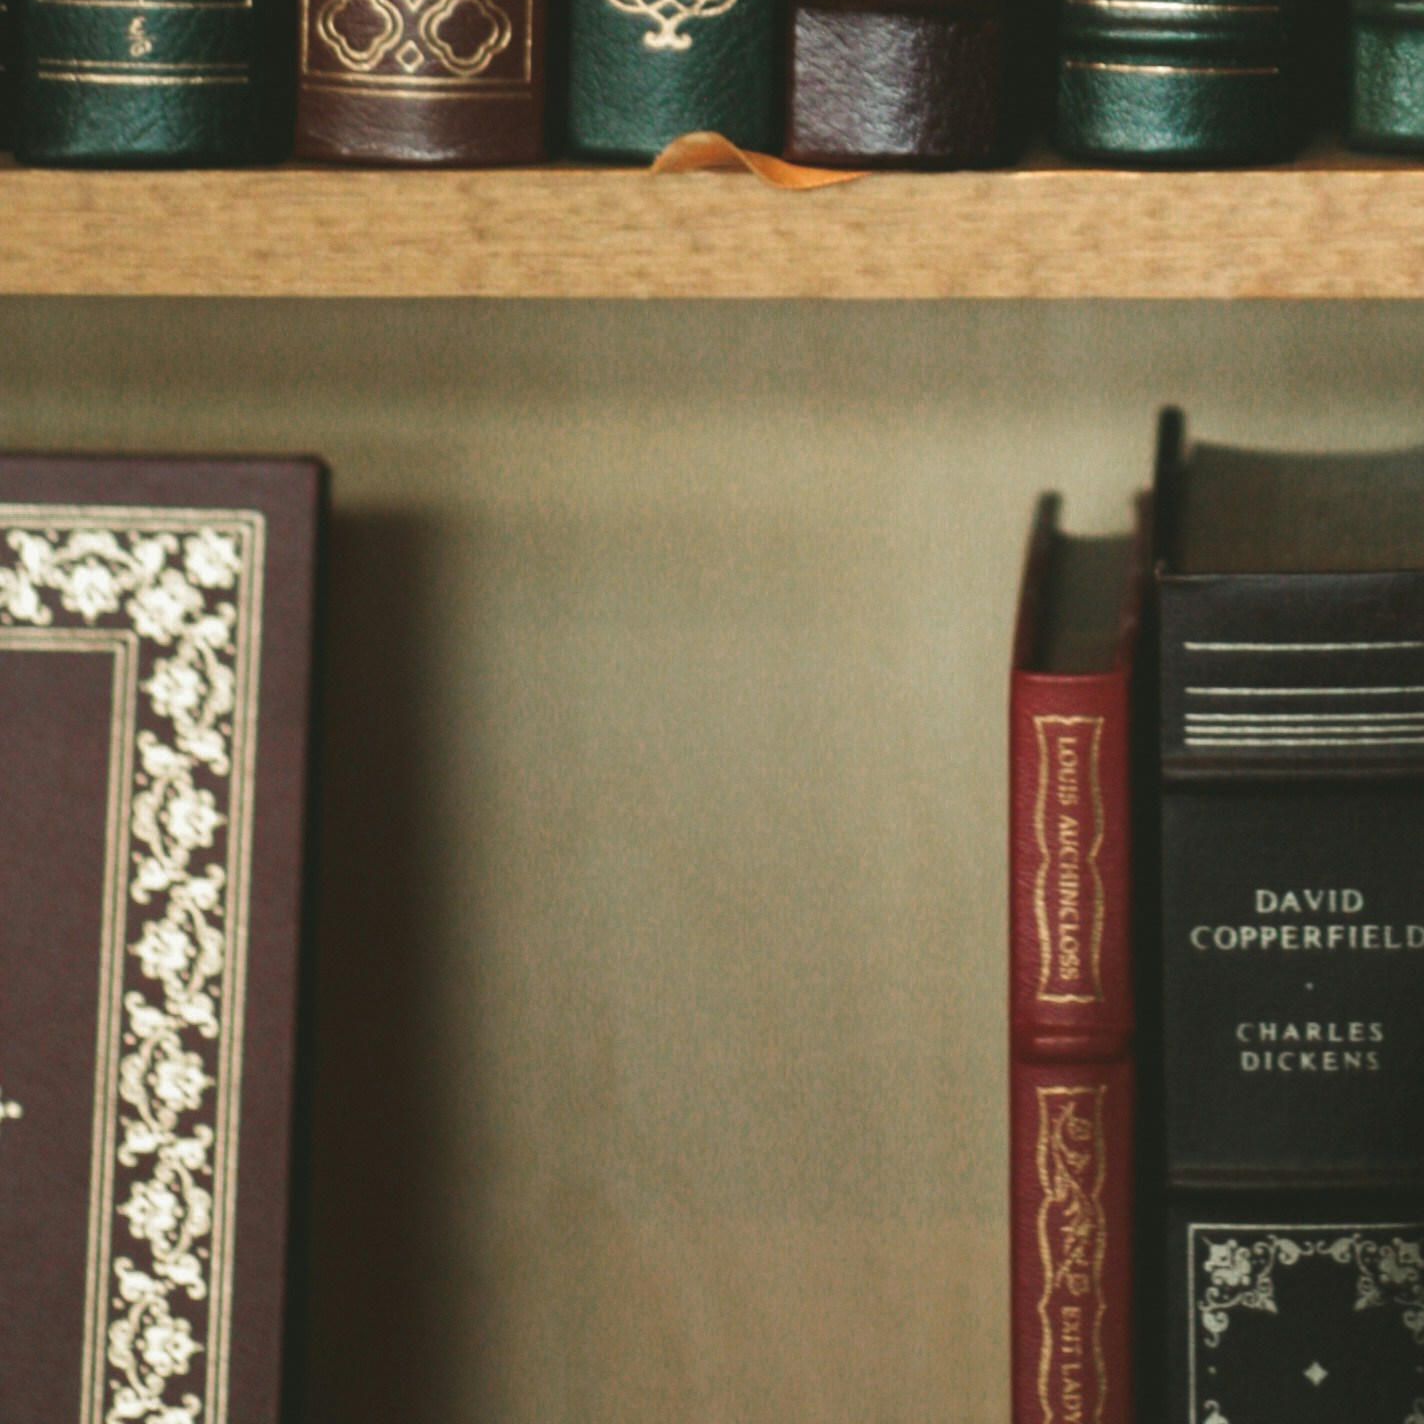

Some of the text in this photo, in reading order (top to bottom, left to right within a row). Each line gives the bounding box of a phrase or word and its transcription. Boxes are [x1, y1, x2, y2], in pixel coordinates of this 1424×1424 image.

[1057, 736, 1080, 982] LOUIS AUCHINCLOSS
[1255, 889, 1364, 915] DAVID
[1237, 1022, 1385, 1042] CHARLES
[1240, 1051, 1381, 1072] DICKENS
[1061, 1305, 1081, 1353] EXIT
